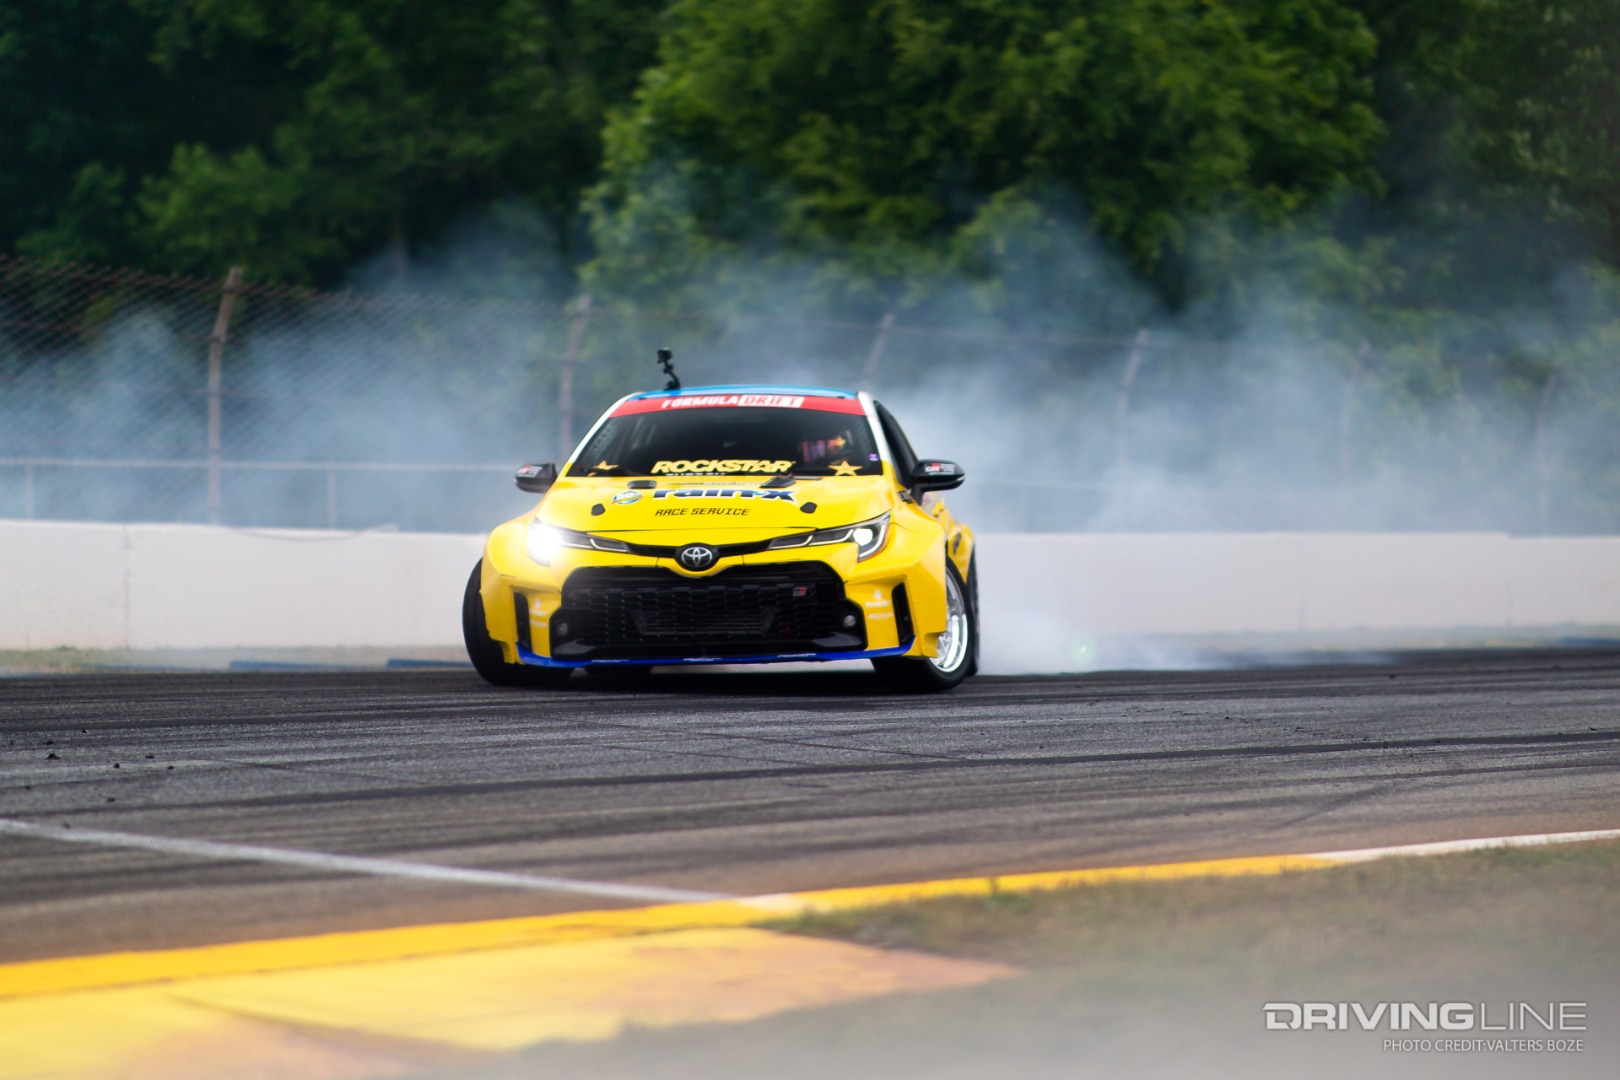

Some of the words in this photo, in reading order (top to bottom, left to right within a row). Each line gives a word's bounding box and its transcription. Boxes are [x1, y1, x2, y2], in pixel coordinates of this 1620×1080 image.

[661, 396, 738, 408] FORMULA
[651, 460, 793, 474] ROCKSTAR
[655, 508, 688, 516] RACE
